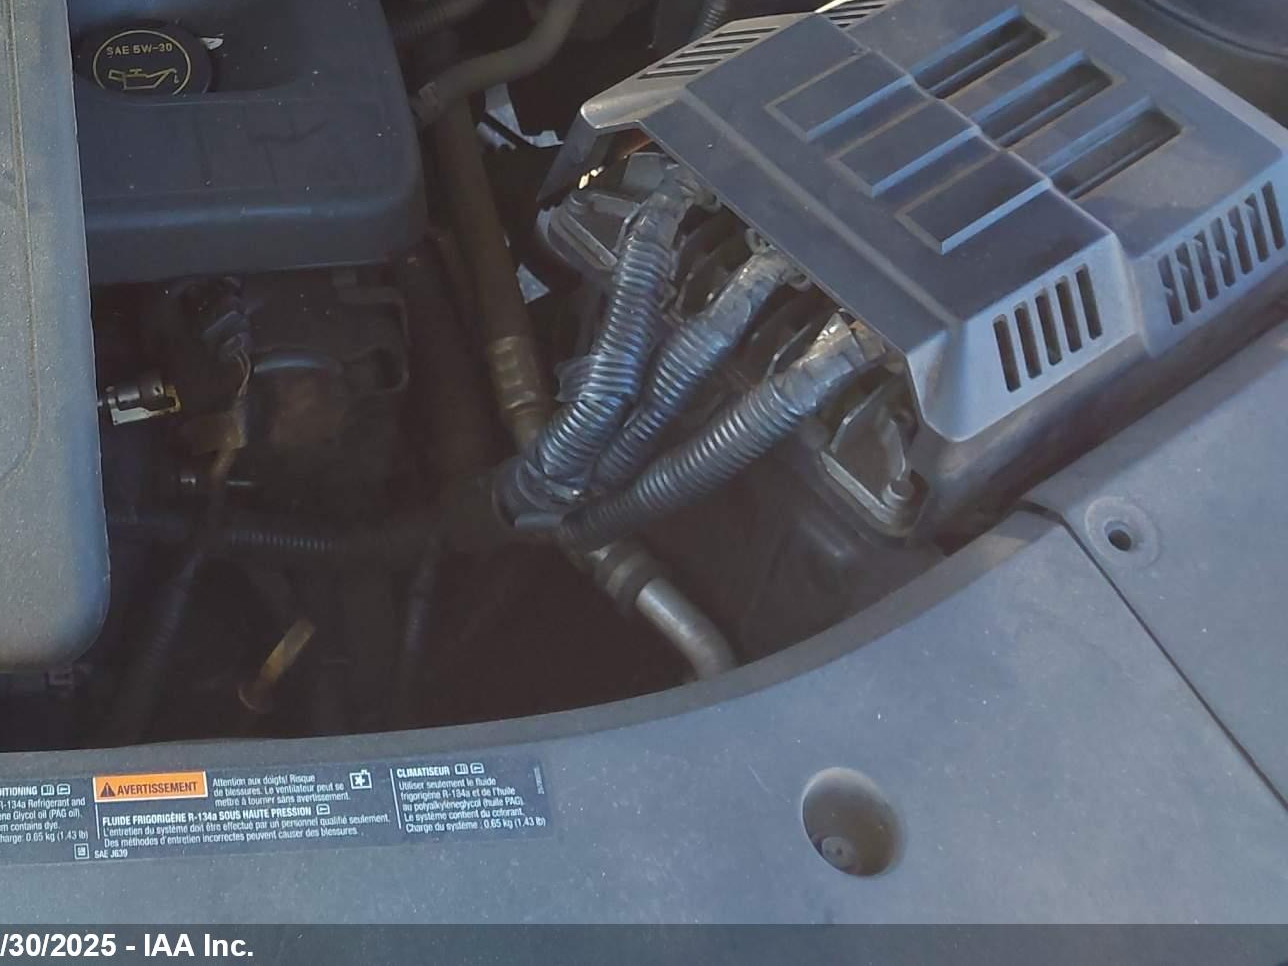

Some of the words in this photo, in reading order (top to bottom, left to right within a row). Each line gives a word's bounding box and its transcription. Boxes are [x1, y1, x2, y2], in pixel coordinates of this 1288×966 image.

[106, 46, 129, 58] SAE
[133, 43, 172, 54] 5W-30
[397, 766, 450, 778] CLIMATISEUR
[212, 777, 246, 788] Attention
[248, 778, 261, 786] aux
[290, 774, 315, 784] Risque
[117, 782, 197, 795] AVERTISSEMENT
[28, 799, 69, 810] Refrigerant
[71, 797, 86, 806] and
[13, 810, 36, 821] Glycol
[38, 810, 47, 819] oil
[49, 809, 66, 819] (PAG
[103, 816, 131, 826] FLUIDE
[188, 812, 217, 822] R-134a
[219, 810, 241, 821] SOUS
[243, 808, 269, 819] HAUTE
[271, 807, 311, 817] PRESSION
[10, 822, 42, 831] contains
[44, 821, 60, 831] dye.
[45, 832, 55, 842] kg
[57, 831, 77, 841] (1.43
[79, 830, 88, 840] lb)
[95, 849, 108, 858] SAE
